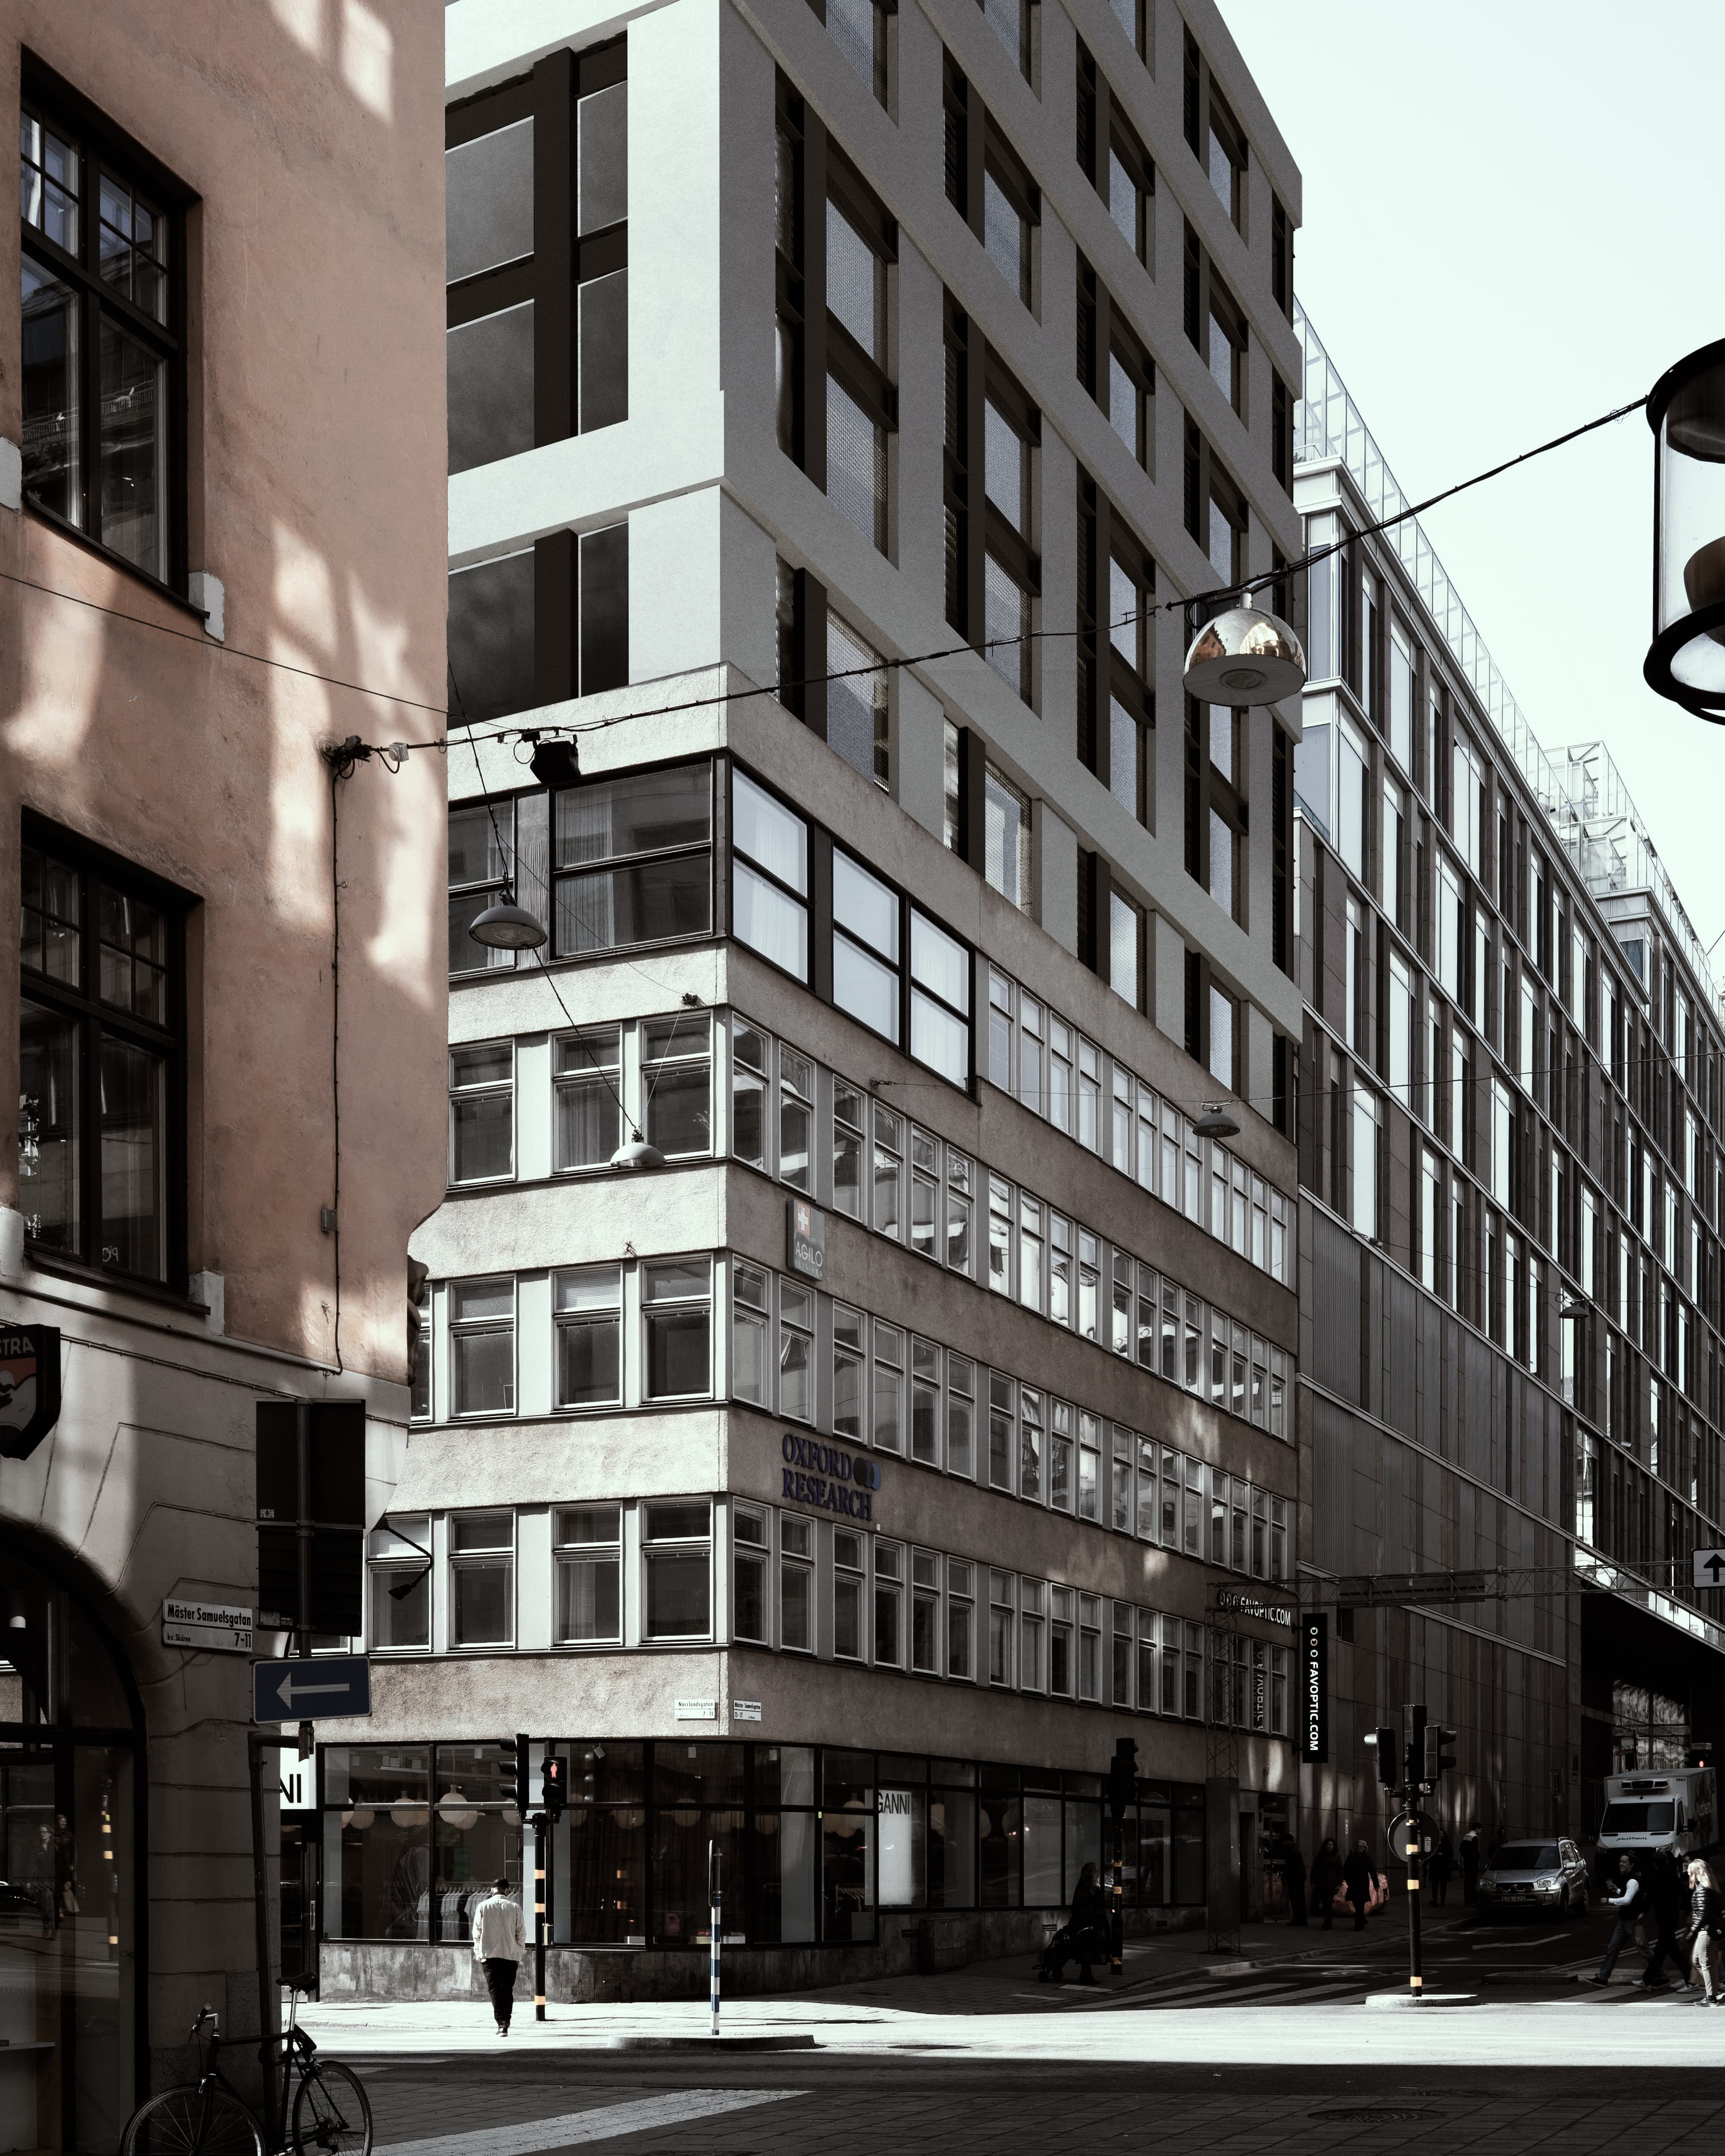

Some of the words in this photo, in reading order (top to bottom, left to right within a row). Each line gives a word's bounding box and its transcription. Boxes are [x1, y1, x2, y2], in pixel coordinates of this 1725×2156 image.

[795, 1241, 822, 1267] AGILO
[0, 1336, 35, 1355] TRA
[782, 1434, 853, 1480] OXFORD
[782, 1468, 872, 1521] RESEARCH
[168, 1604, 195, 1620] Mäster
[197, 1608, 251, 1627] Samuelsgatan
[1240, 1596, 1291, 1626] FAVOPTIC.COM
[175, 1634, 191, 1642] Skären
[234, 1632, 251, 1648] 7-11
[1310, 1661, 1318, 1751] FAVOPTIC.COM
[878, 1792, 910, 1815] GANNI
